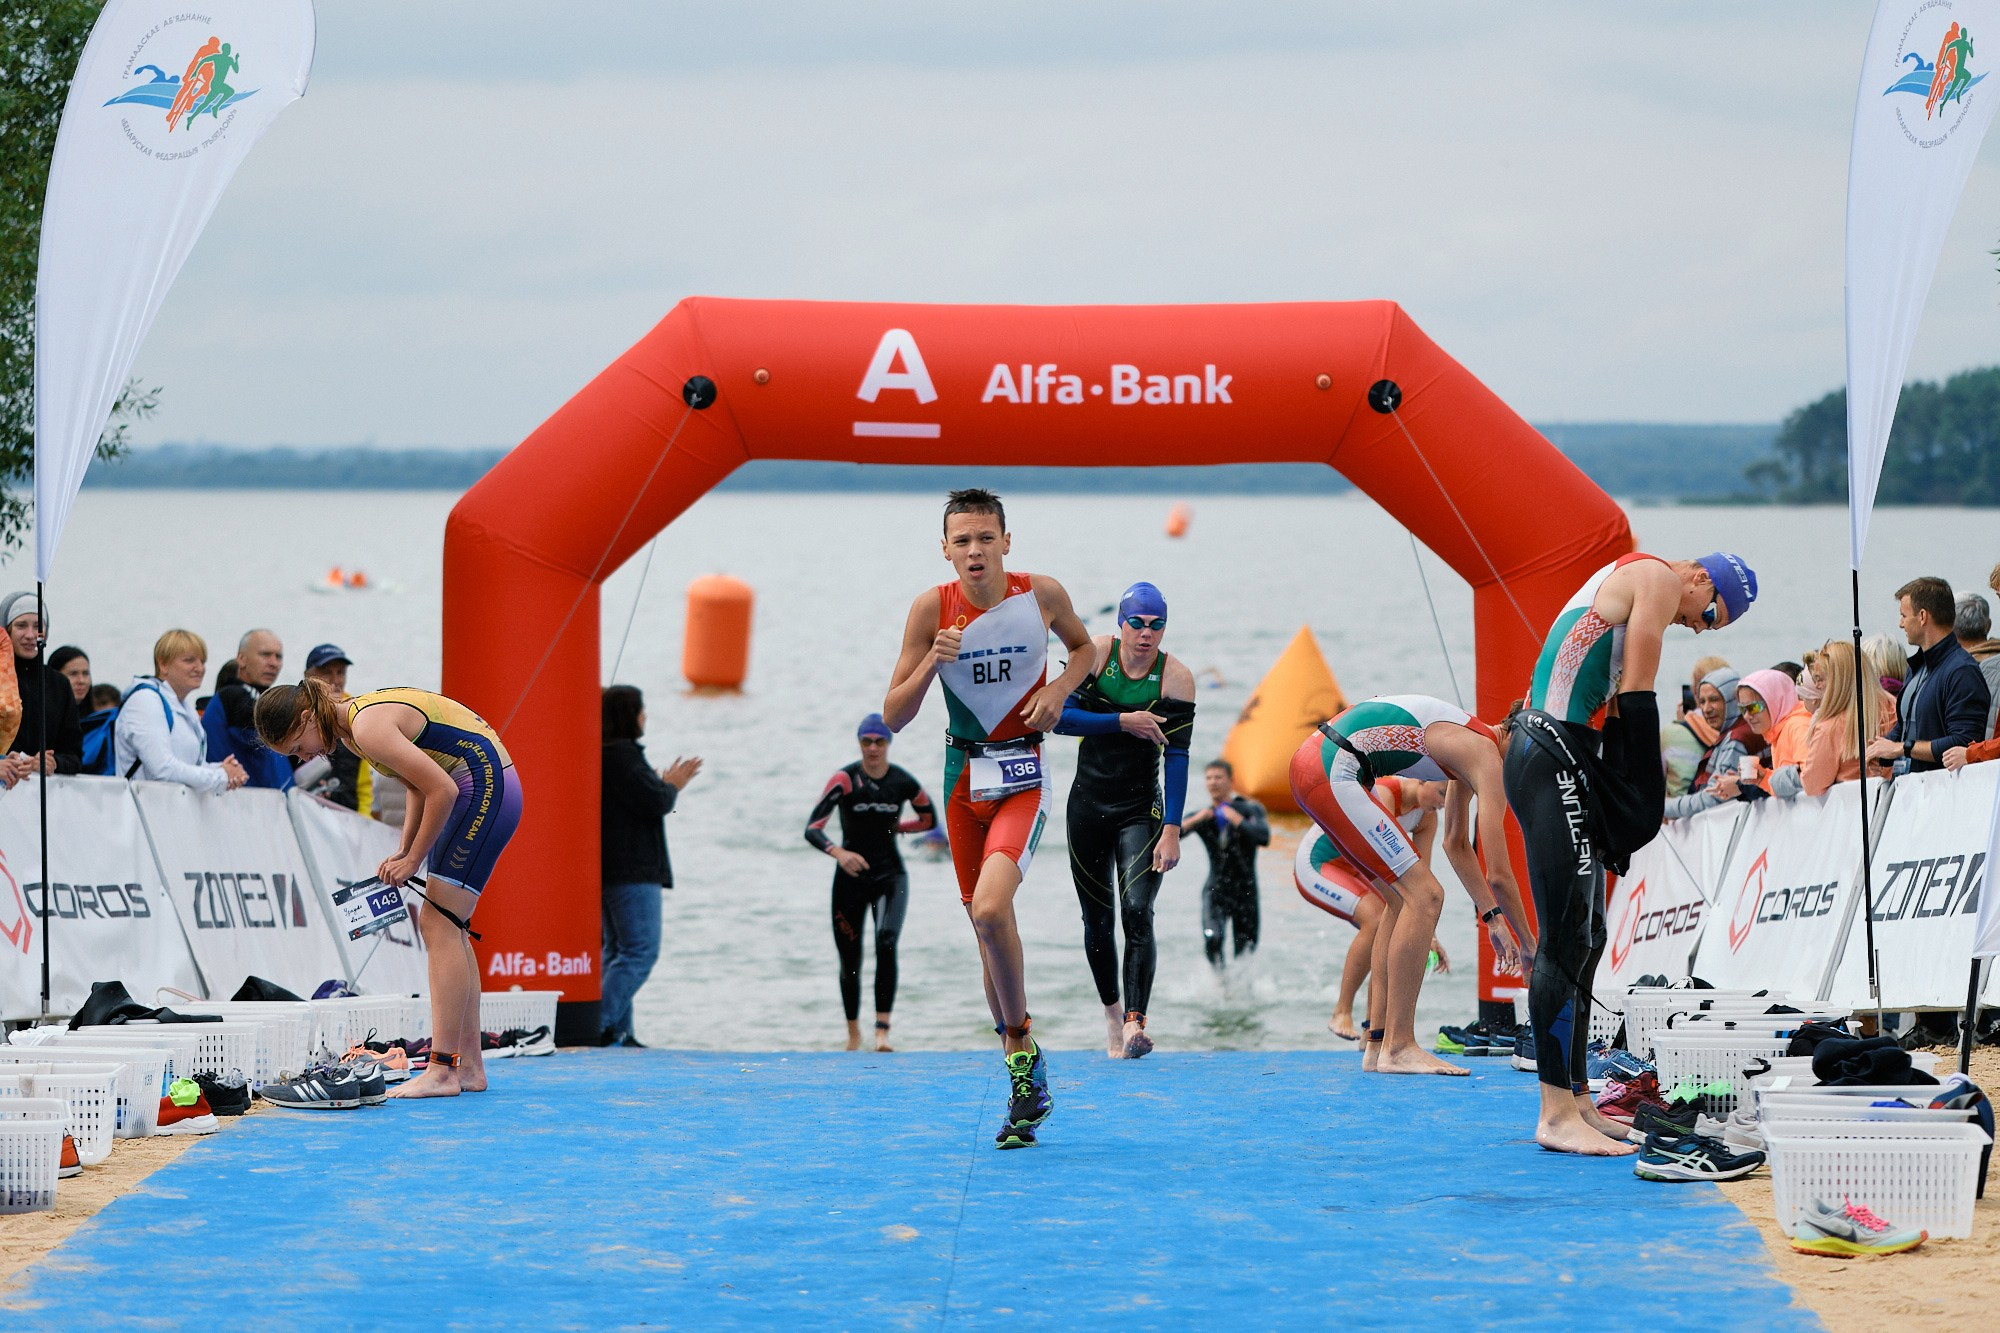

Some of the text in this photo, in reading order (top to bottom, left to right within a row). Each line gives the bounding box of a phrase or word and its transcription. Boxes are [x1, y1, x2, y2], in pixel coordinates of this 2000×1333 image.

[122, 25, 161, 80] ГРАМАДСКАЕ
[958, 646, 1028, 660] BELAZ
[972, 659, 1012, 685] BLR
[456, 739, 489, 763] MOILEV
[1005, 761, 1036, 777] 136
[480, 763, 494, 814] TRIATHLON
[853, 802, 899, 812] orca
[465, 815, 485, 841] TEAM
[1555, 770, 1592, 876] NEPTUNE
[22, 882, 152, 920] COROS
[184, 871, 277, 929] ZONE3
[372, 891, 398, 910] 143
[1756, 880, 1839, 925] COROS
[1867, 854, 1965, 923] ZONE3
[1633, 899, 1706, 944] COROS
